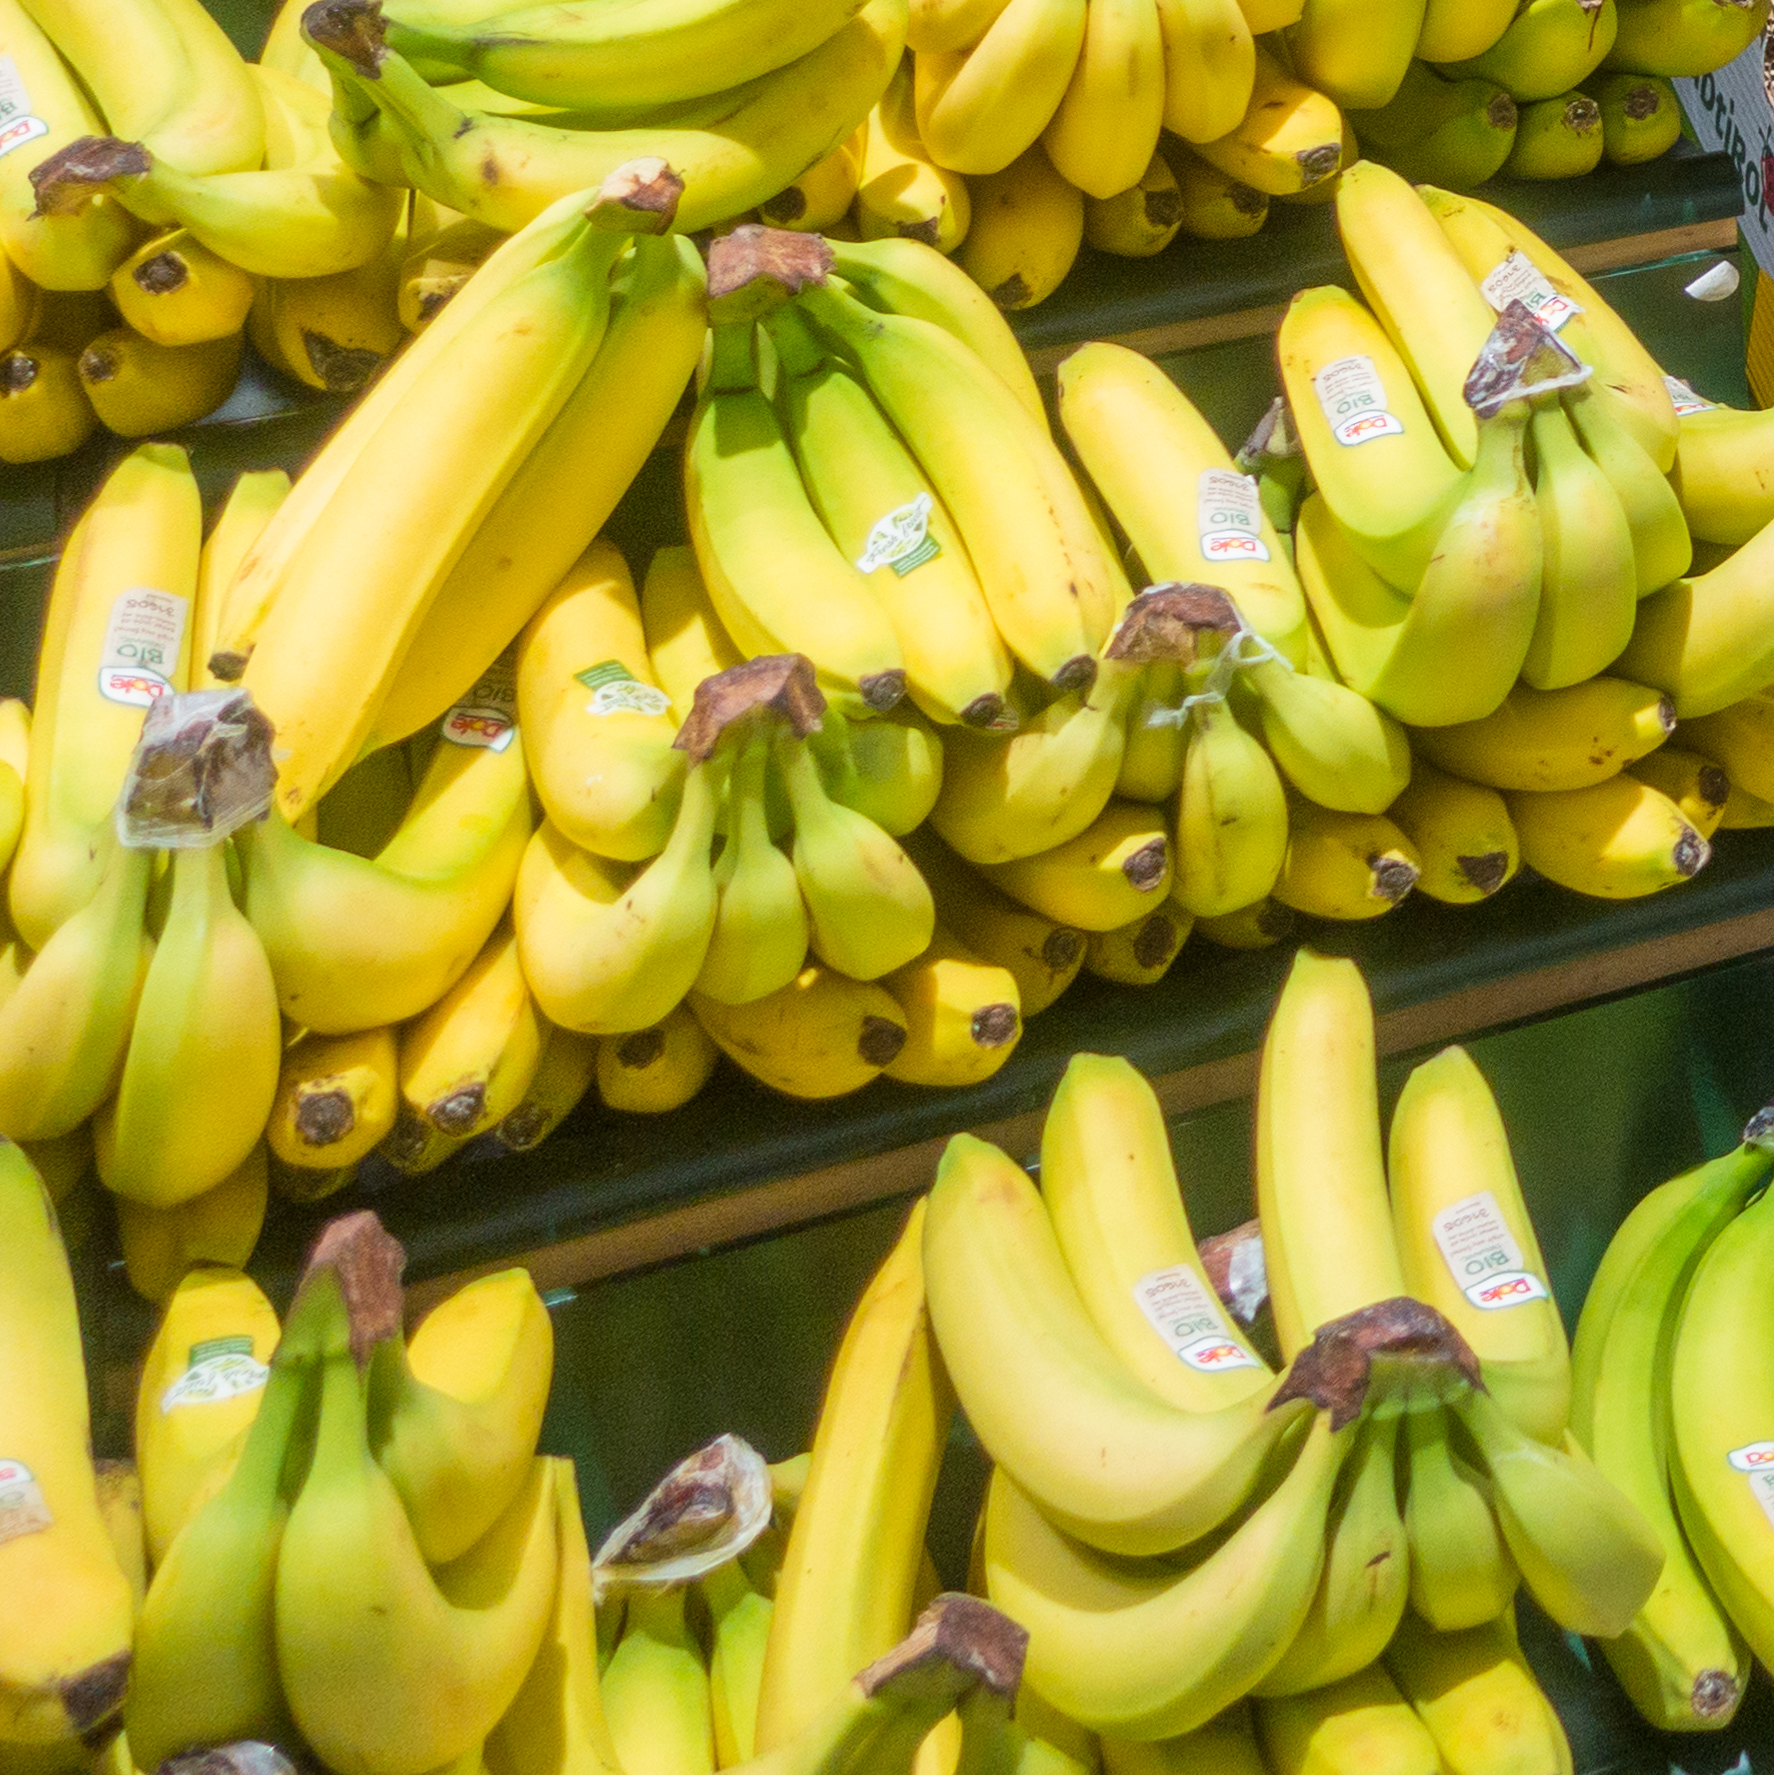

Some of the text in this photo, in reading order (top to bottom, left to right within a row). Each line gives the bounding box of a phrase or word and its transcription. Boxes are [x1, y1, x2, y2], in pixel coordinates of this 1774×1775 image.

[1337, 394, 1376, 414] BIO
[1345, 417, 1388, 438] Dole
[1210, 512, 1251, 527] BIO
[1211, 539, 1257, 553] Dole
[116, 644, 164, 665] BIO
[110, 676, 164, 699] Dole
[451, 716, 501, 739] Dole
[1464, 1251, 1510, 1275] BIO
[1481, 1279, 1532, 1303] Dole
[1175, 1318, 1218, 1338] BIO
[1196, 1346, 1246, 1364] Dole
